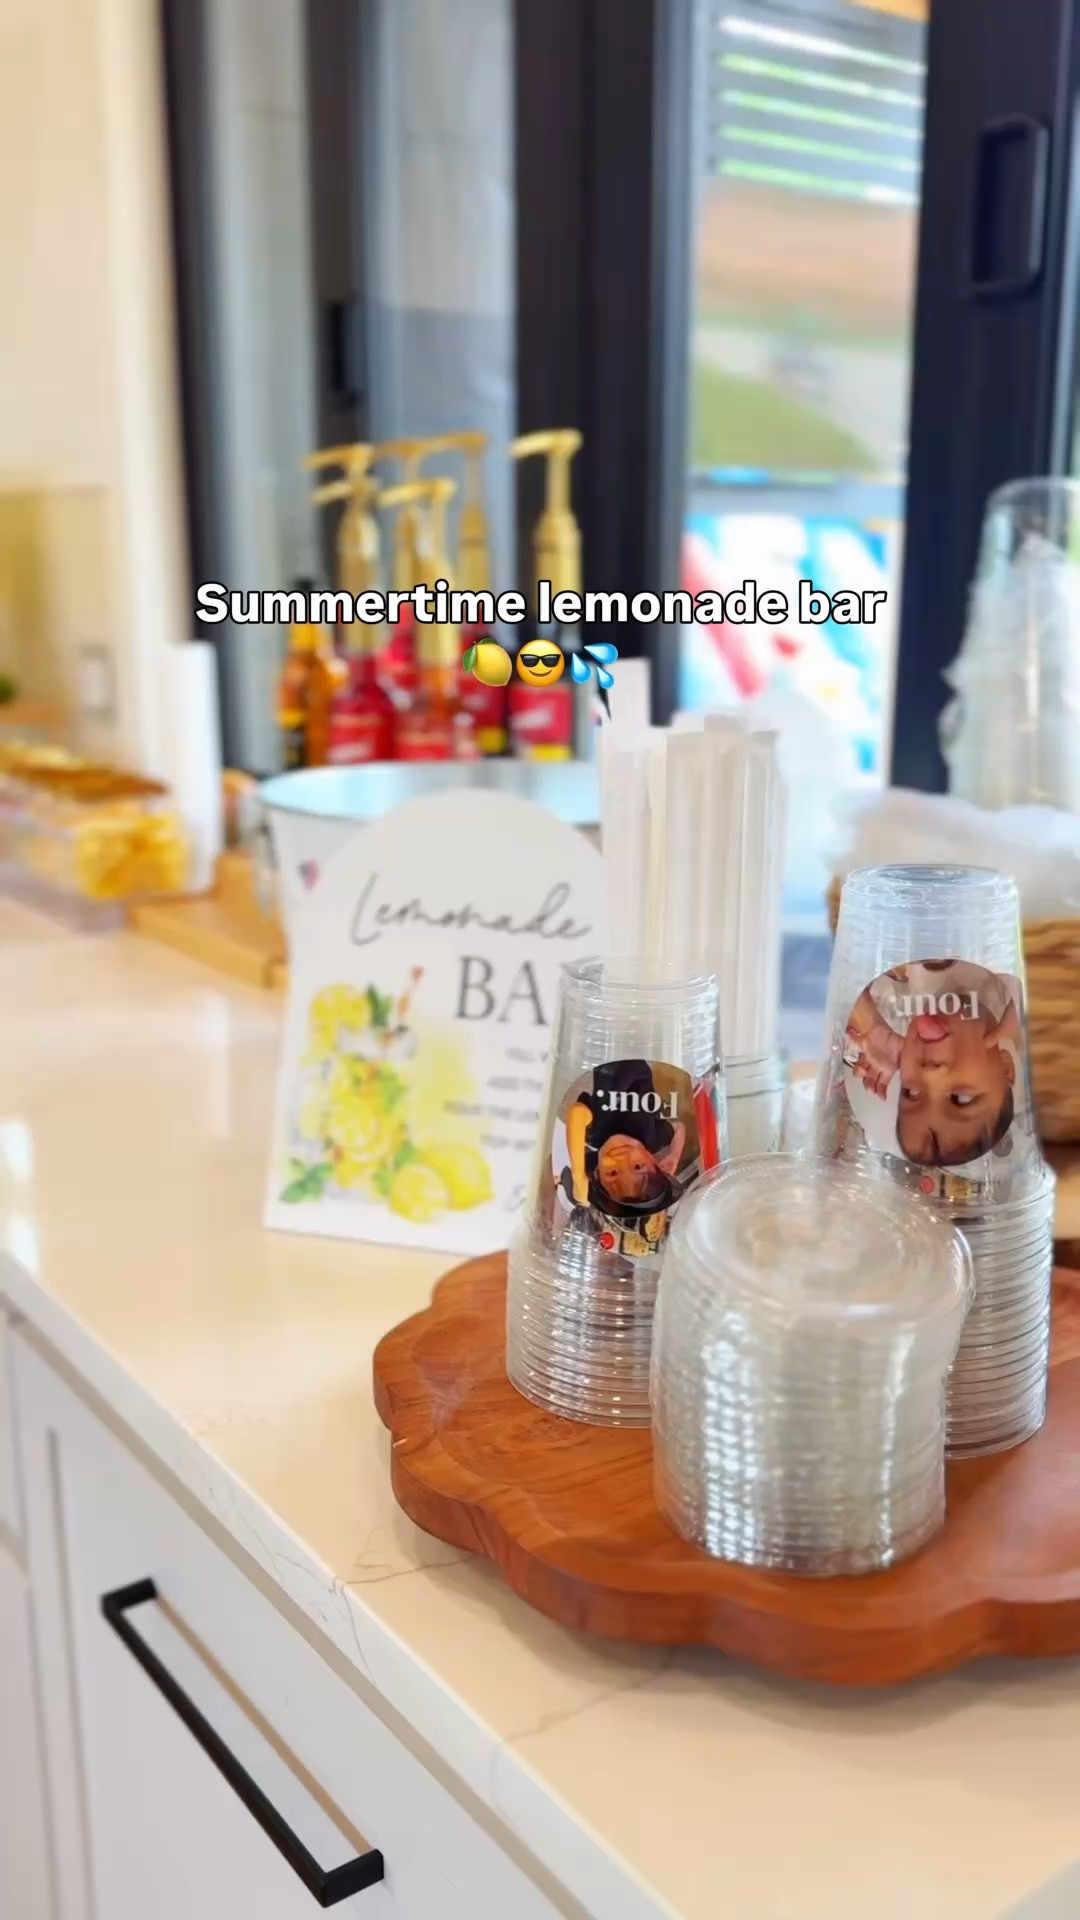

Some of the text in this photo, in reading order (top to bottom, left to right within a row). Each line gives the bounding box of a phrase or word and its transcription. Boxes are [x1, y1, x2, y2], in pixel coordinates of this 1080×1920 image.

[351, 871, 593, 946] Lemonade
[454, 955, 562, 1026] BA
[596, 1089, 680, 1120] Four.
